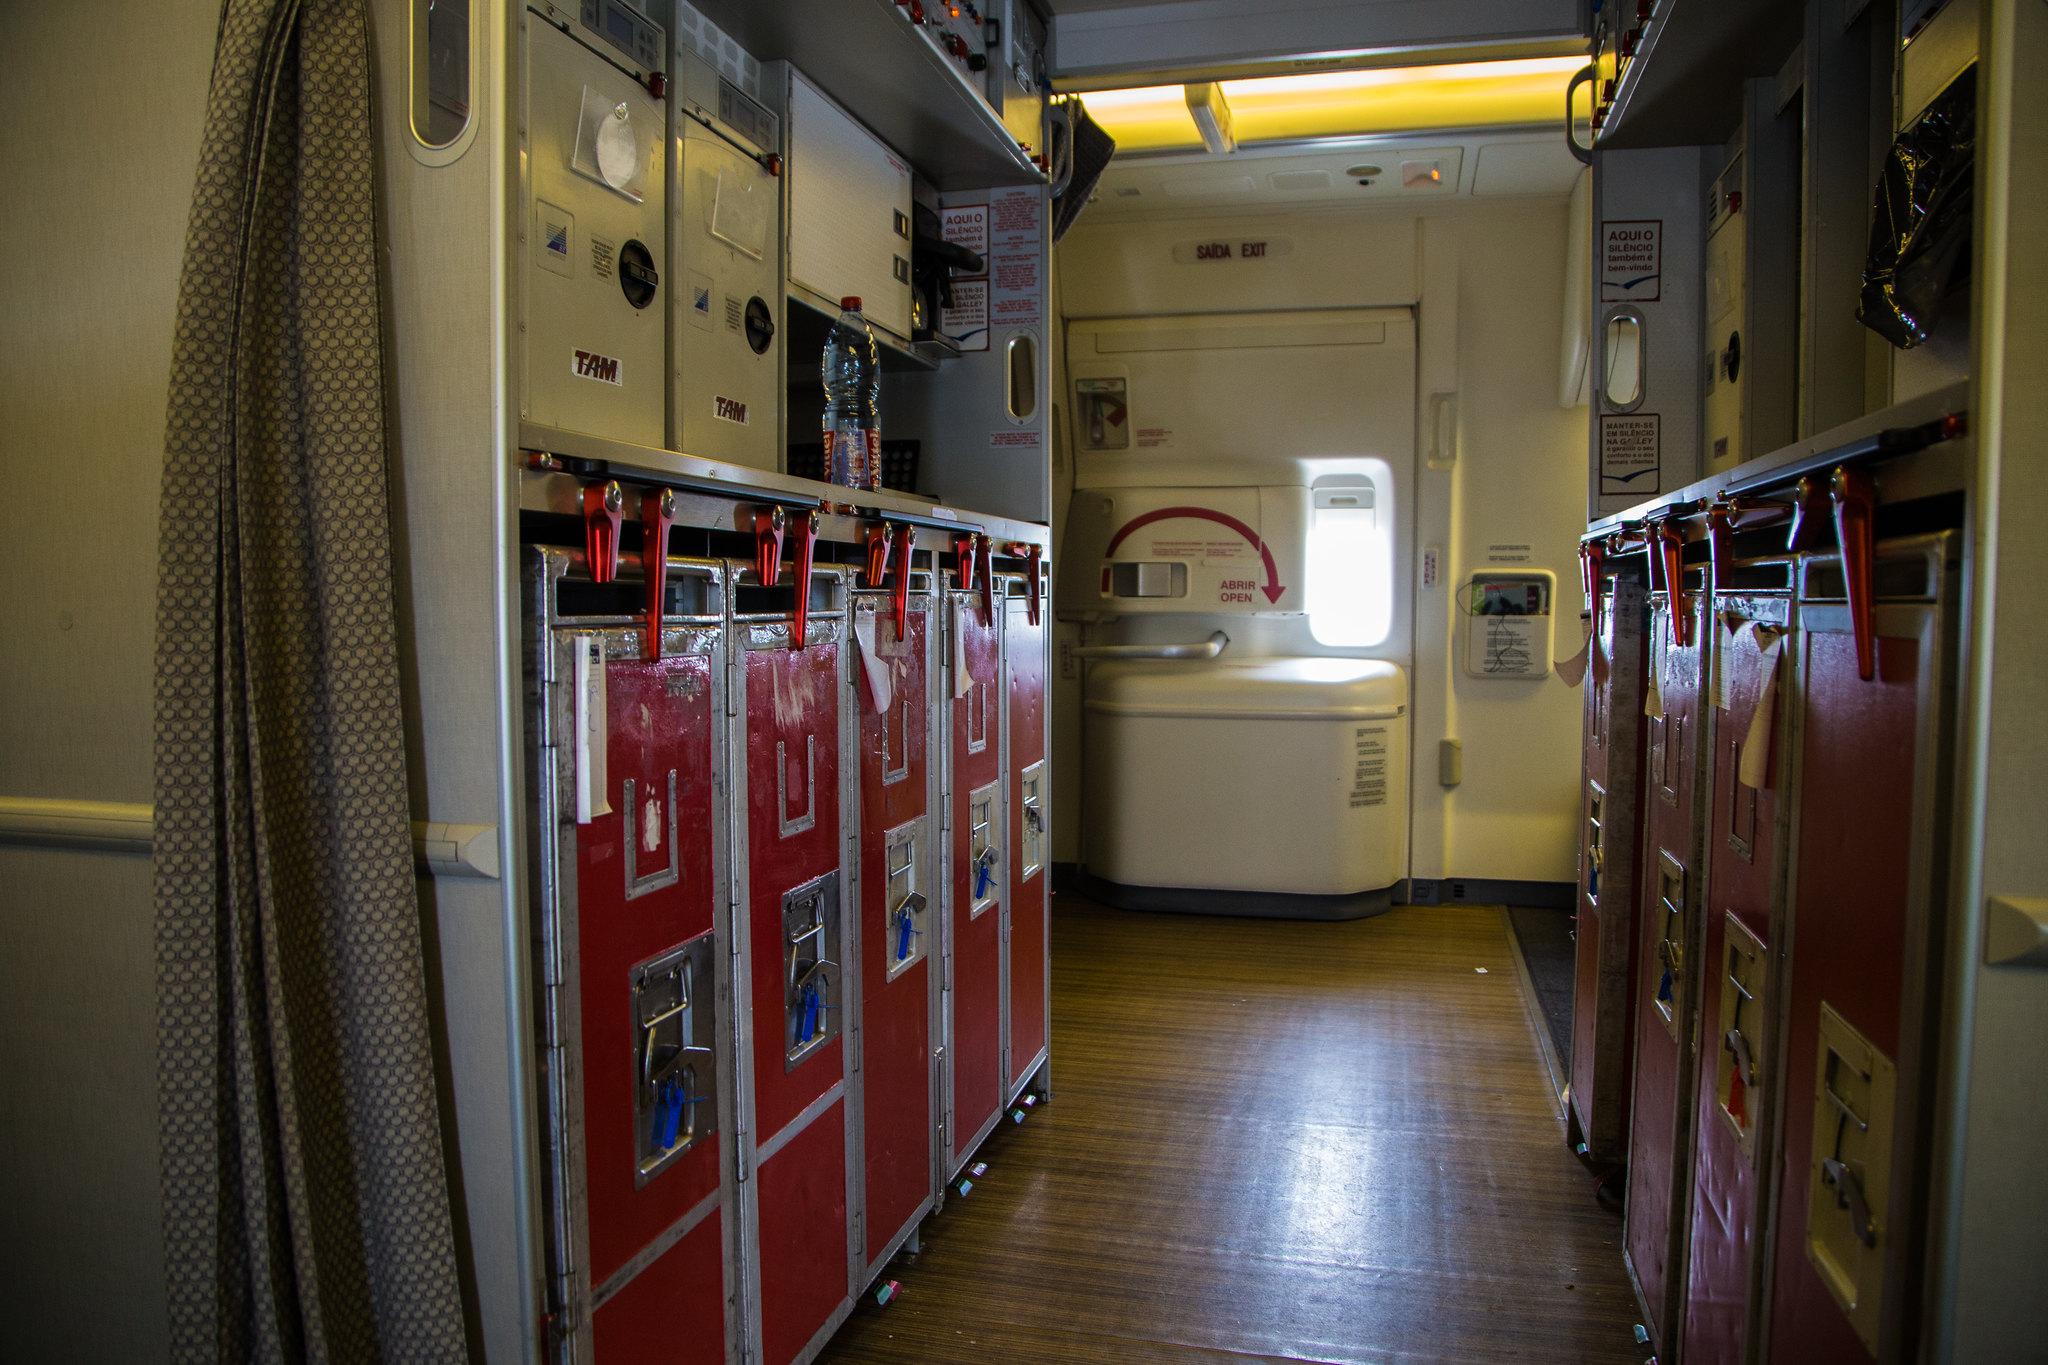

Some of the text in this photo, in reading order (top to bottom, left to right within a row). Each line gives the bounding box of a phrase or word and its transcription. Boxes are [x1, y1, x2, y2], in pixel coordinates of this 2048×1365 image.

[946, 213, 983, 225] AQUI O
[1609, 230, 1654, 241] AQUI O
[1196, 241, 1267, 259] SAÍDA EXIT
[1608, 243, 1653, 252] SILÊNCIO
[1608, 253, 1646, 262] também
[1608, 263, 1653, 272] bem-vindo
[574, 349, 618, 383] TAM
[715, 395, 747, 424] TAM
[1220, 580, 1256, 590] ABRIR
[1220, 593, 1253, 602] OPEN
